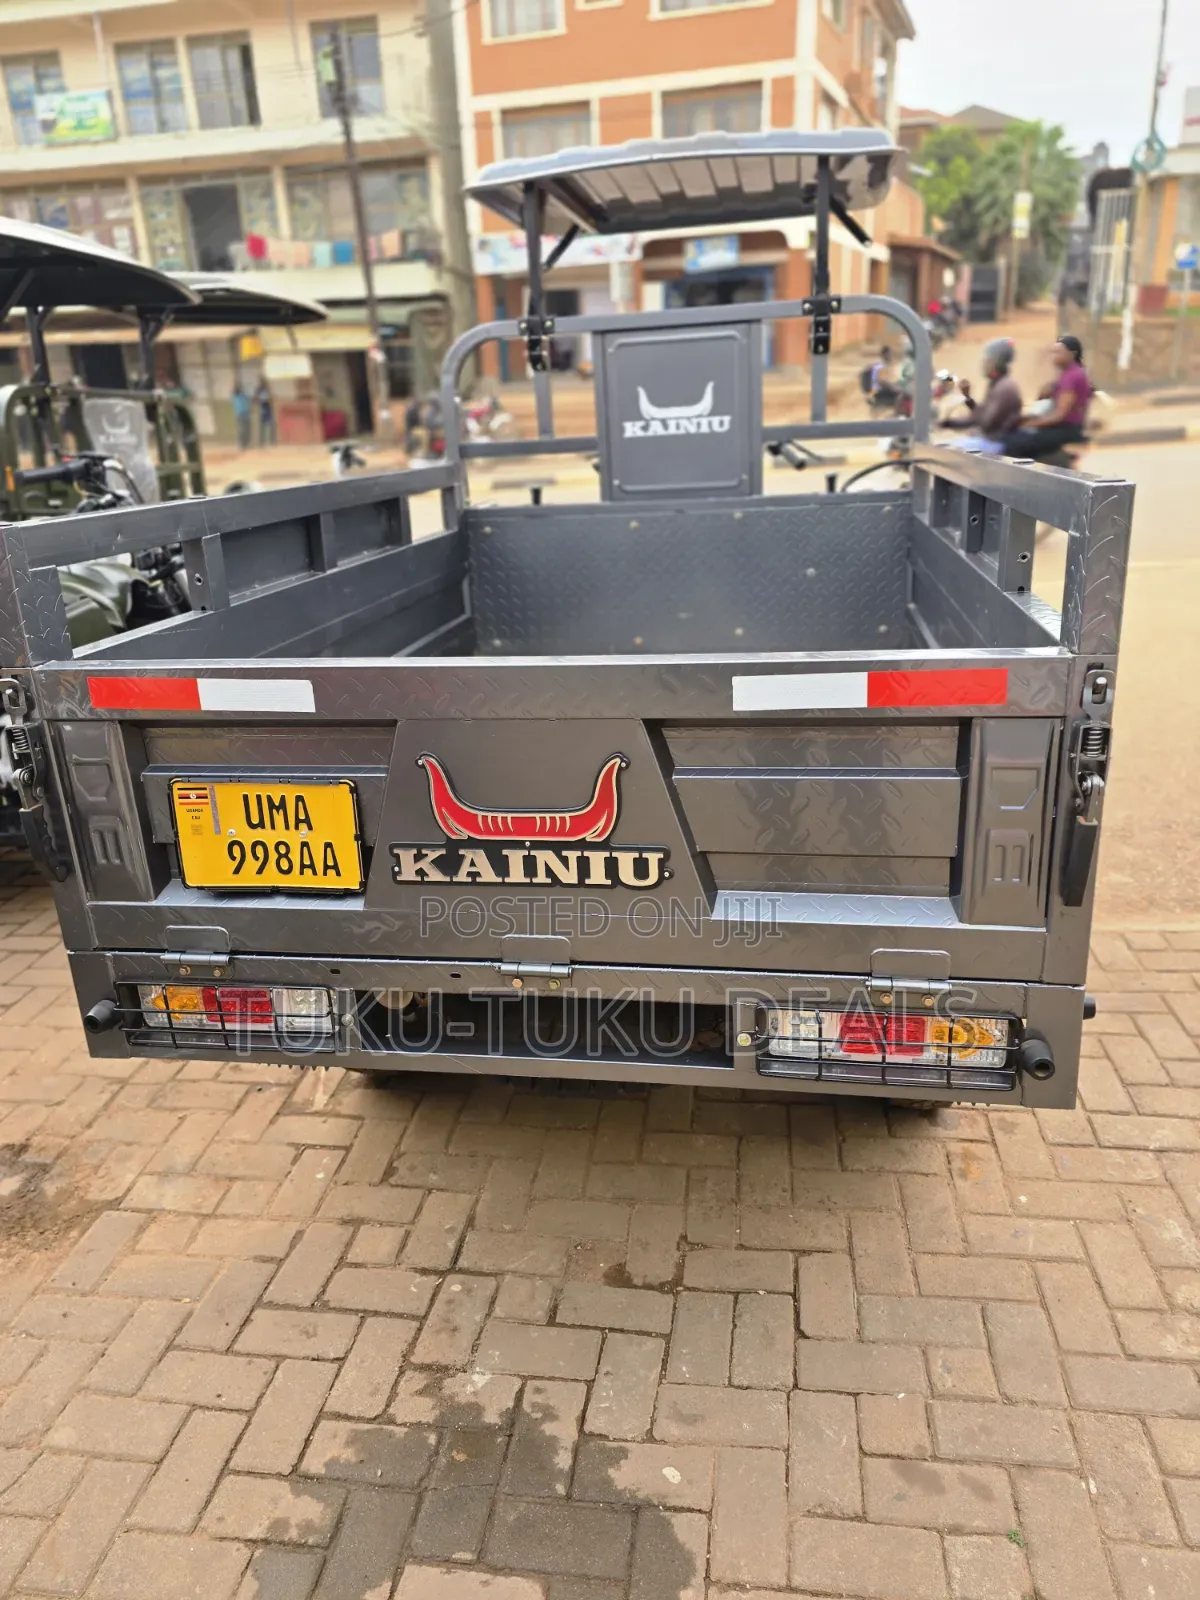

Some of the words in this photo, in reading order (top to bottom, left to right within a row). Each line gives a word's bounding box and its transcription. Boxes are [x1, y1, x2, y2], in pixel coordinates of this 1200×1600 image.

[622, 415, 731, 438] KAINIU
[242, 793, 314, 831] UMA
[227, 839, 342, 877] 998AA
[393, 848, 665, 887] KAINIU
